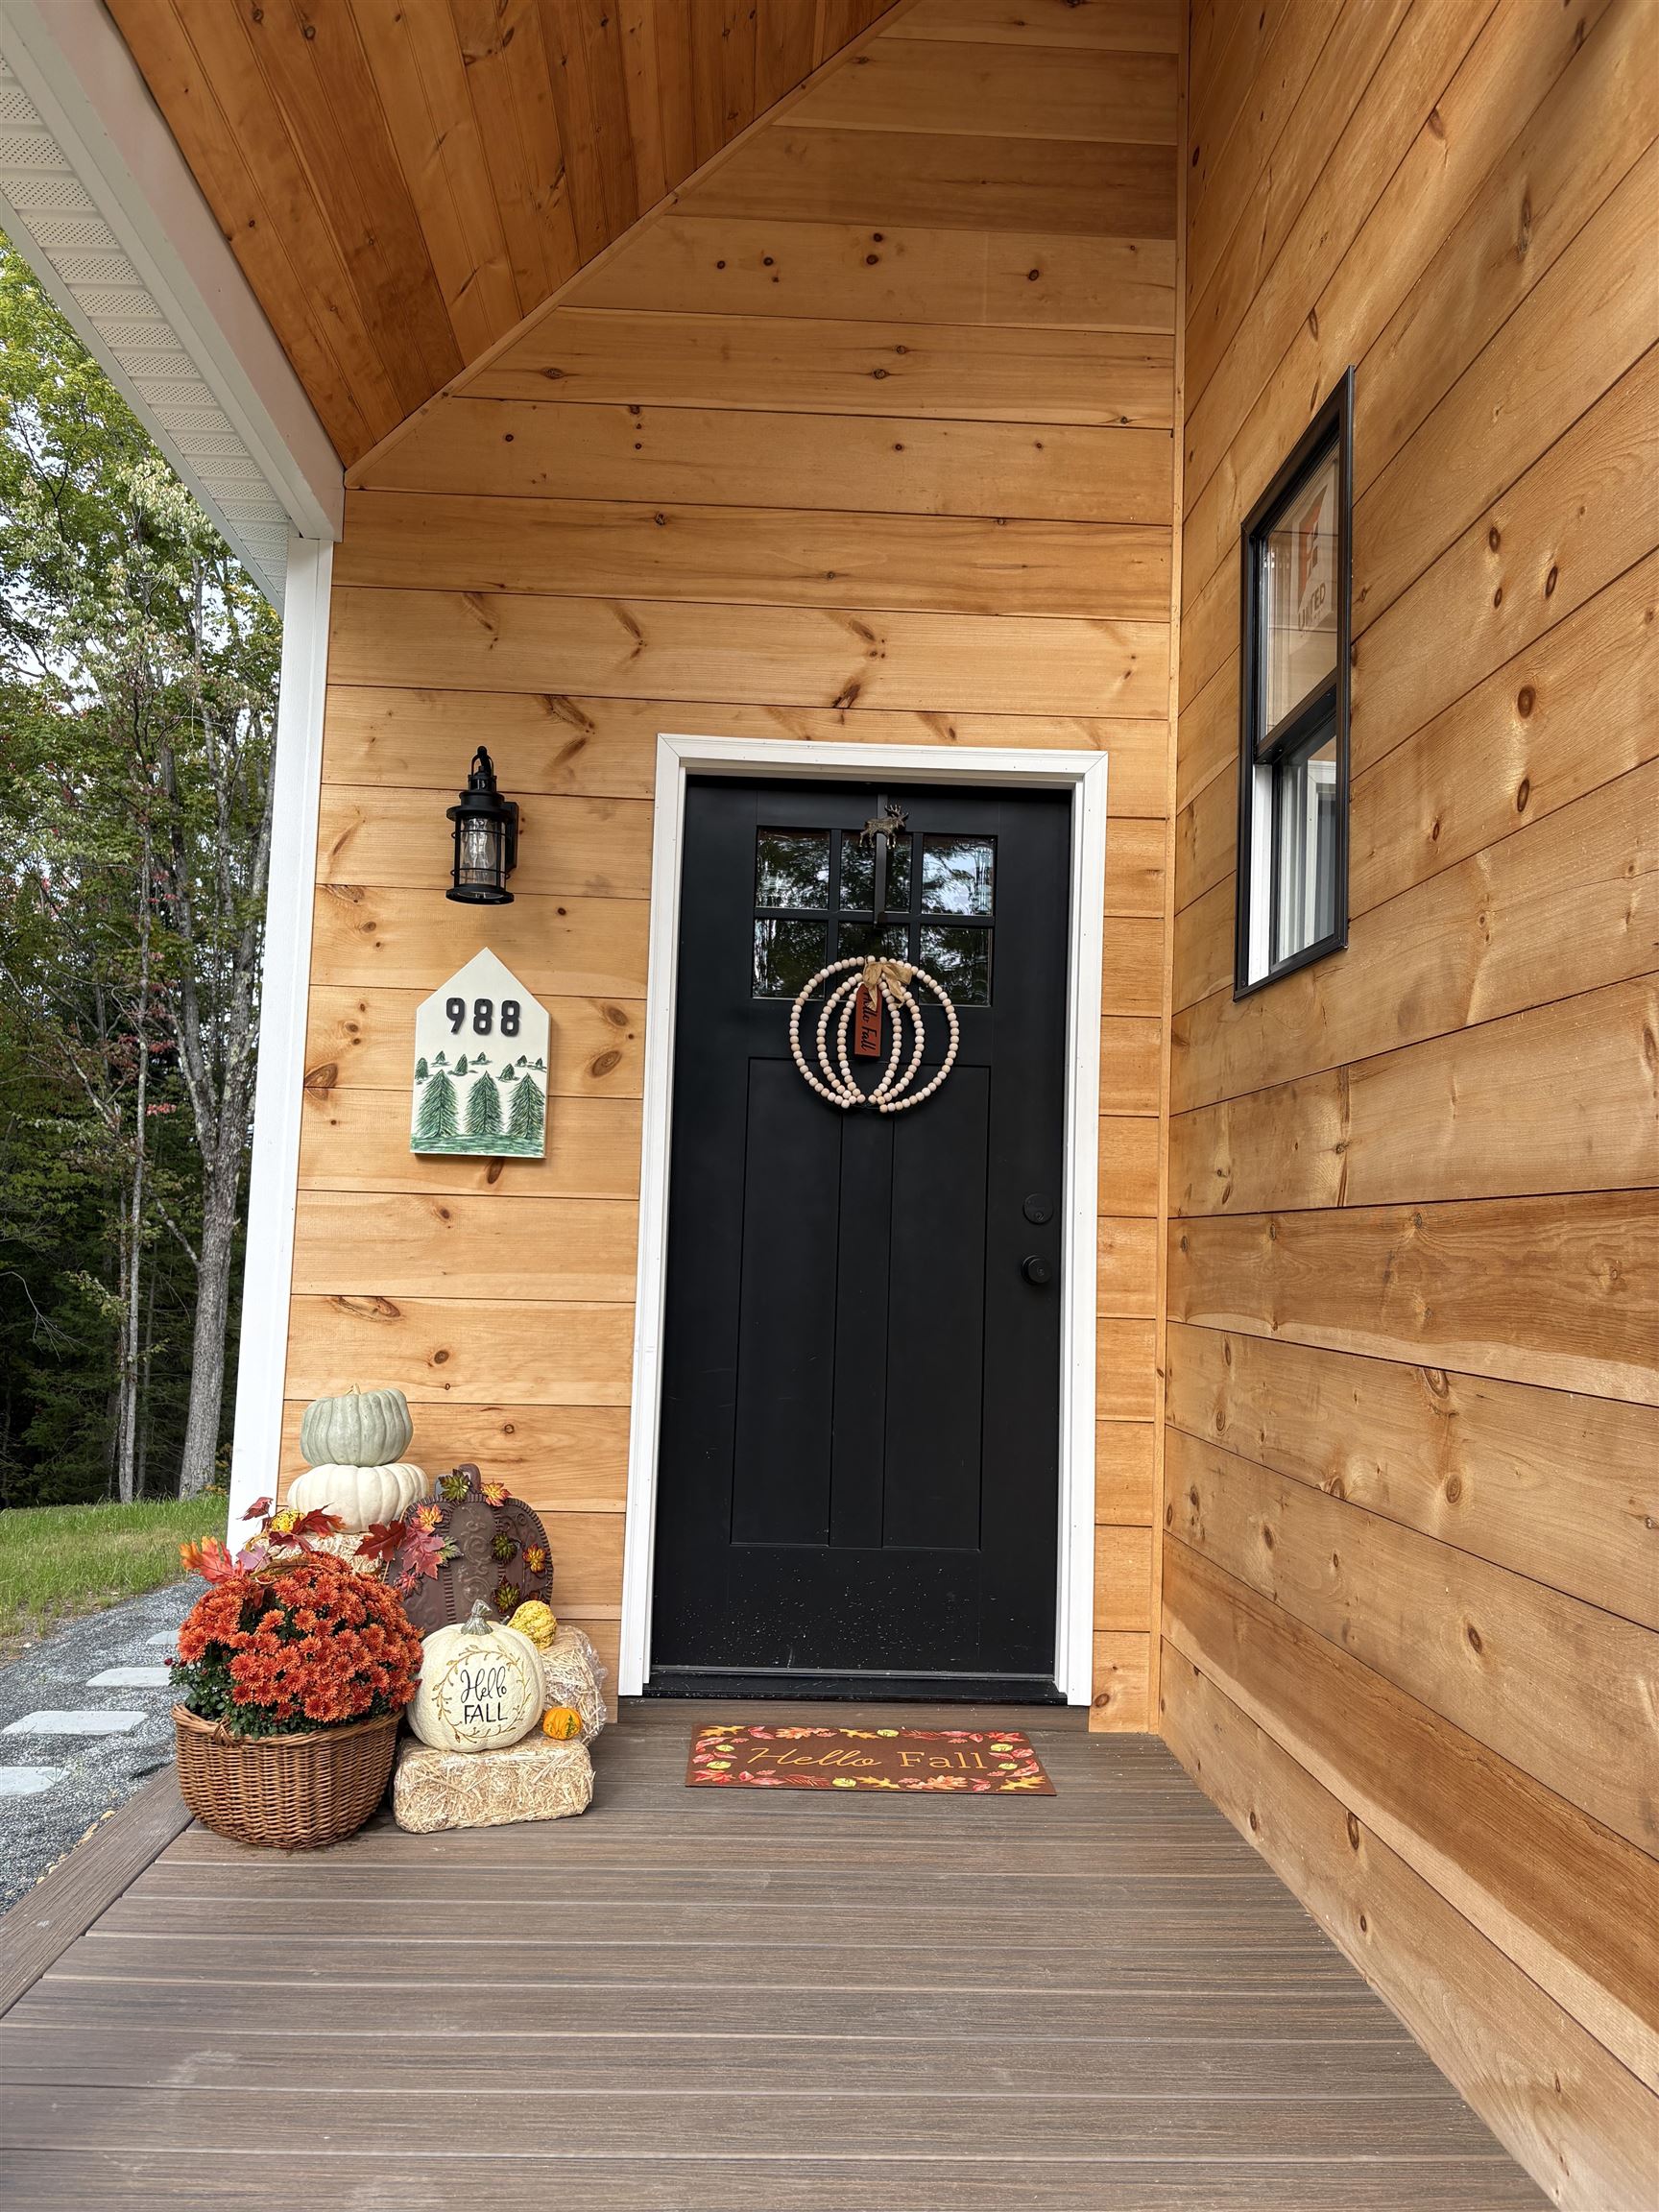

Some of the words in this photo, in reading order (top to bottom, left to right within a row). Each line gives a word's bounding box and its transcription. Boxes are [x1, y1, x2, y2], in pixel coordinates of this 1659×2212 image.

[445, 997, 521, 1037] 988
[860, 1025, 878, 1051] Fall
[460, 1666, 507, 1703] Hello
[464, 1702, 508, 1724] FALL
[747, 1747, 882, 1767] Hello
[897, 1751, 988, 1769] Fall
